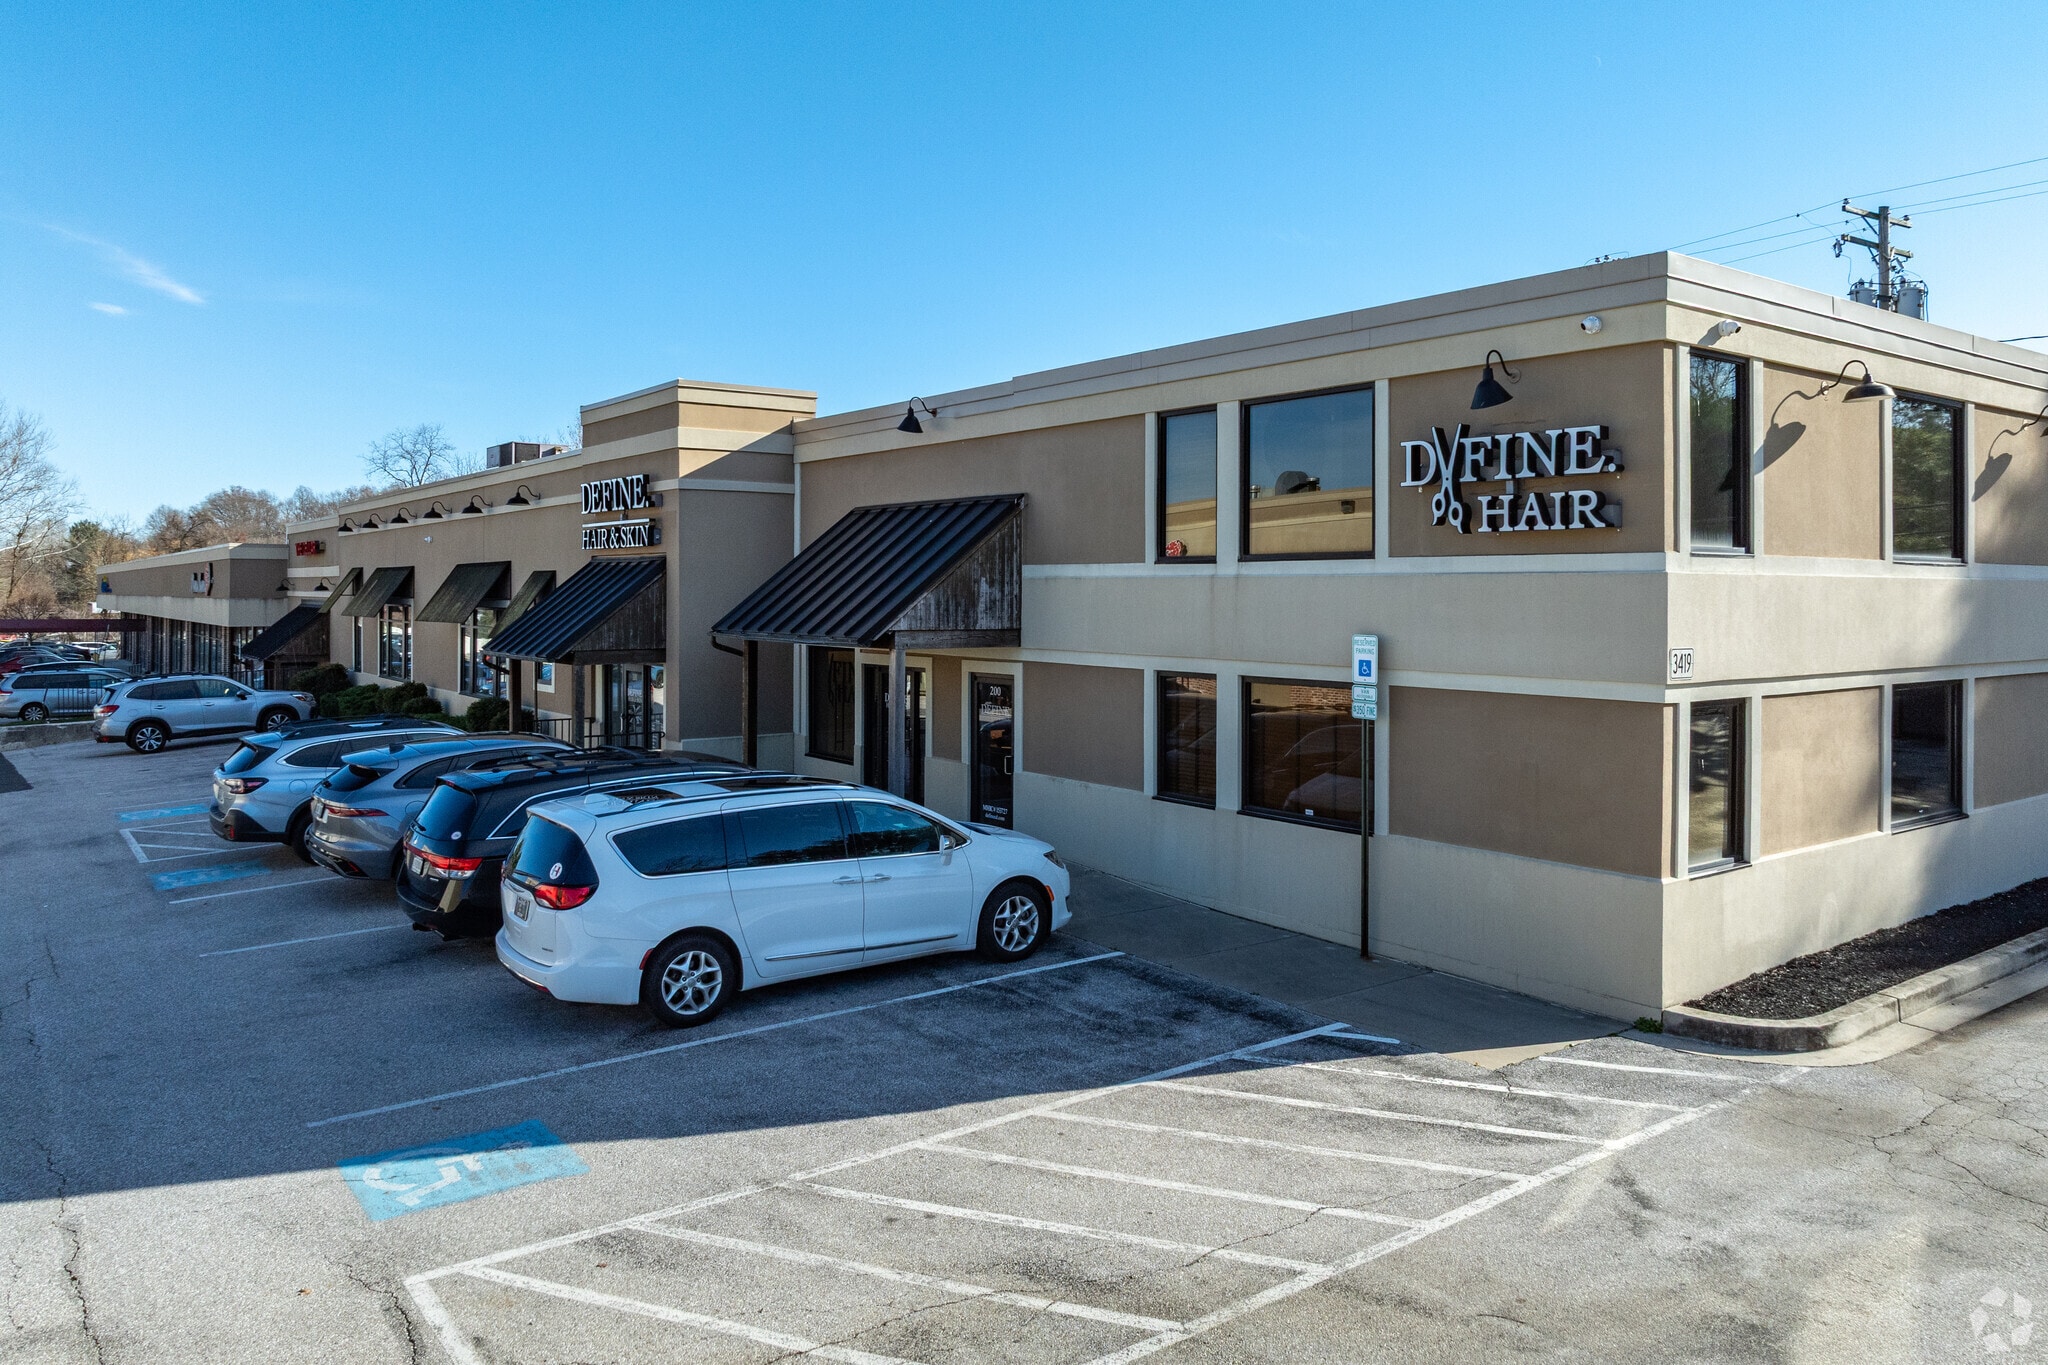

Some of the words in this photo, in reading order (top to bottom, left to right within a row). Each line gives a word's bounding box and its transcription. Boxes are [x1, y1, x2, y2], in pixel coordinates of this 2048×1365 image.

[581, 474, 649, 515] DEFINE.
[1477, 489, 1606, 533] HAIR
[582, 528, 609, 550] HAIR
[609, 526, 620, 549] &
[620, 523, 650, 548] SKIN
[1673, 653, 1691, 674] 3419
[990, 686, 1001, 696] 200
[1353, 705, 1366, 715] $350
[1366, 706, 1376, 716] FINE
